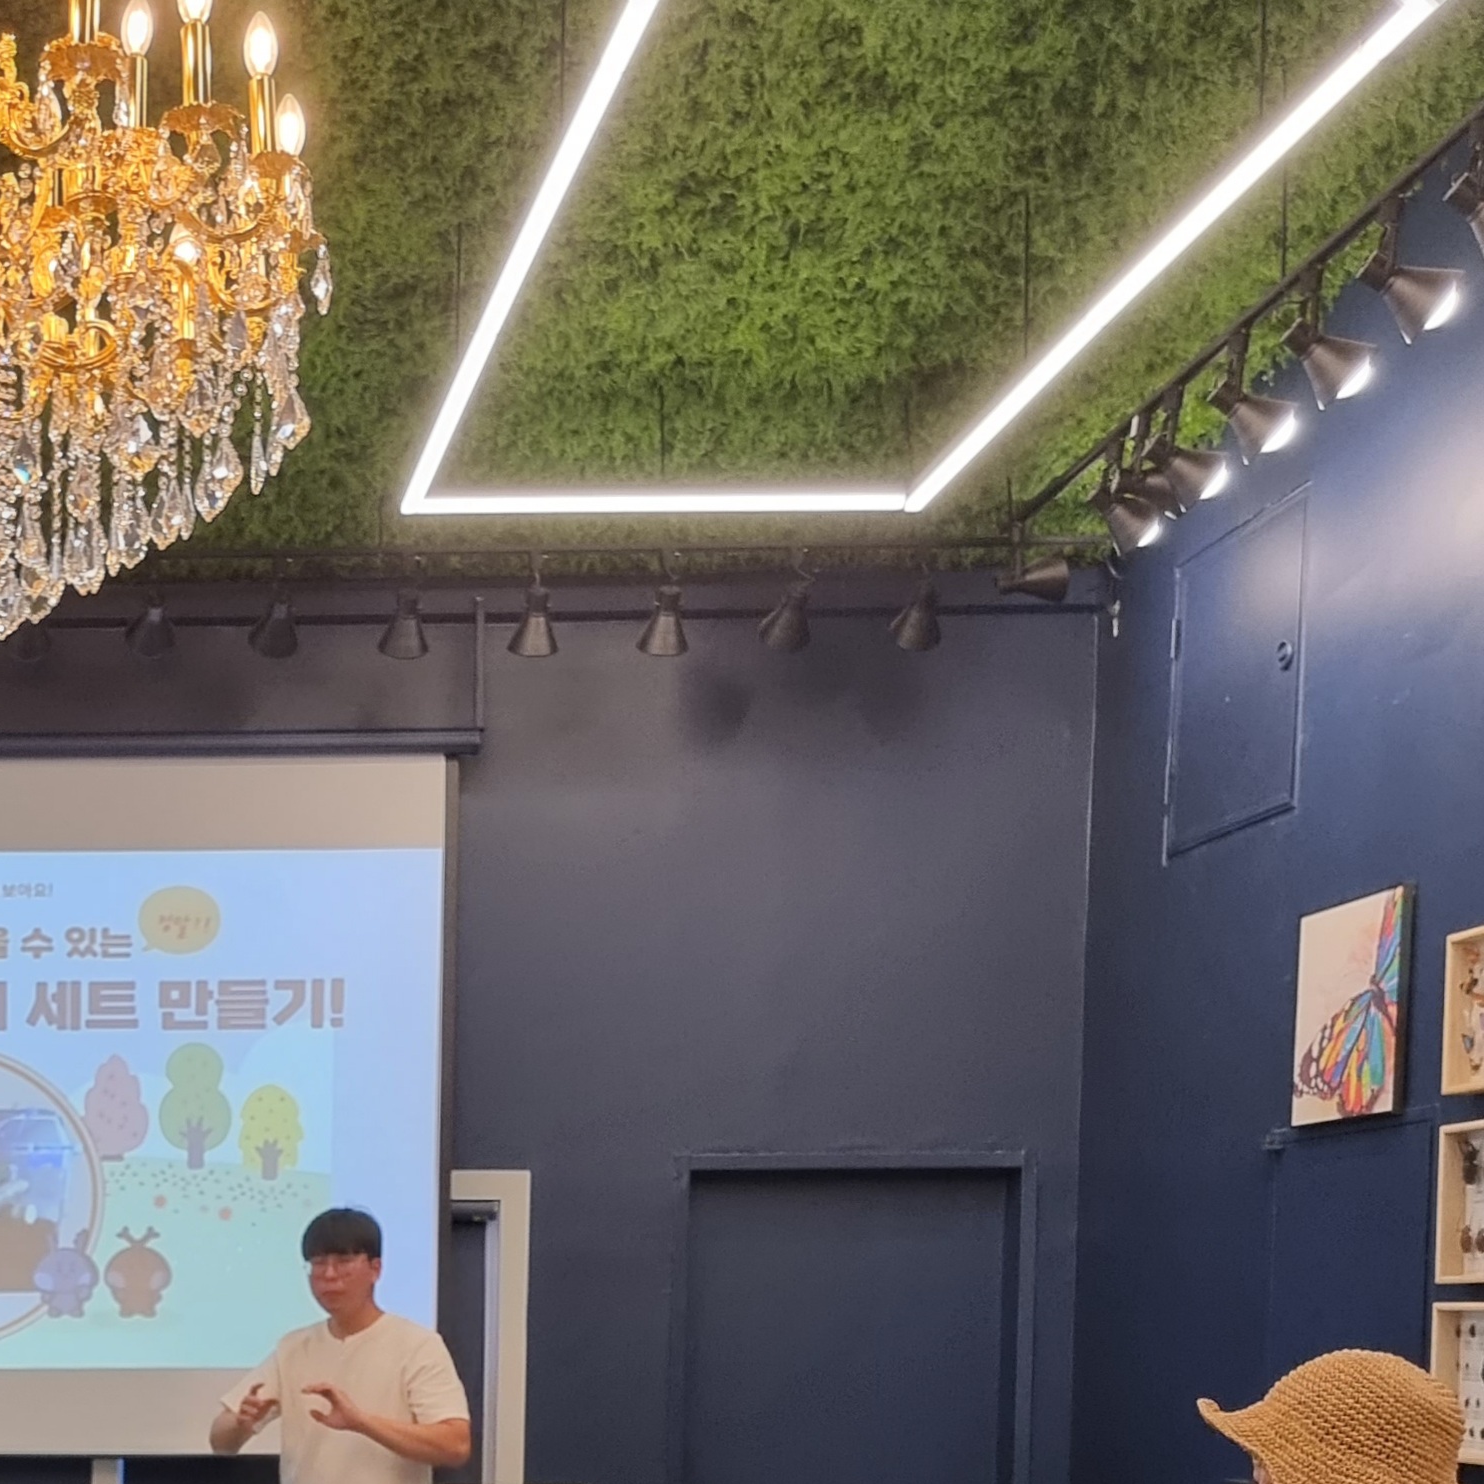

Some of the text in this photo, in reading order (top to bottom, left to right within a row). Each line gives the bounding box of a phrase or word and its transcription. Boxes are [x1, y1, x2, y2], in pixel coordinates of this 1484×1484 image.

[20, 926, 55, 961] 수
[64, 925, 134, 961] 있는
[26, 978, 141, 1033] 세트
[158, 976, 347, 1033] 만들기!
